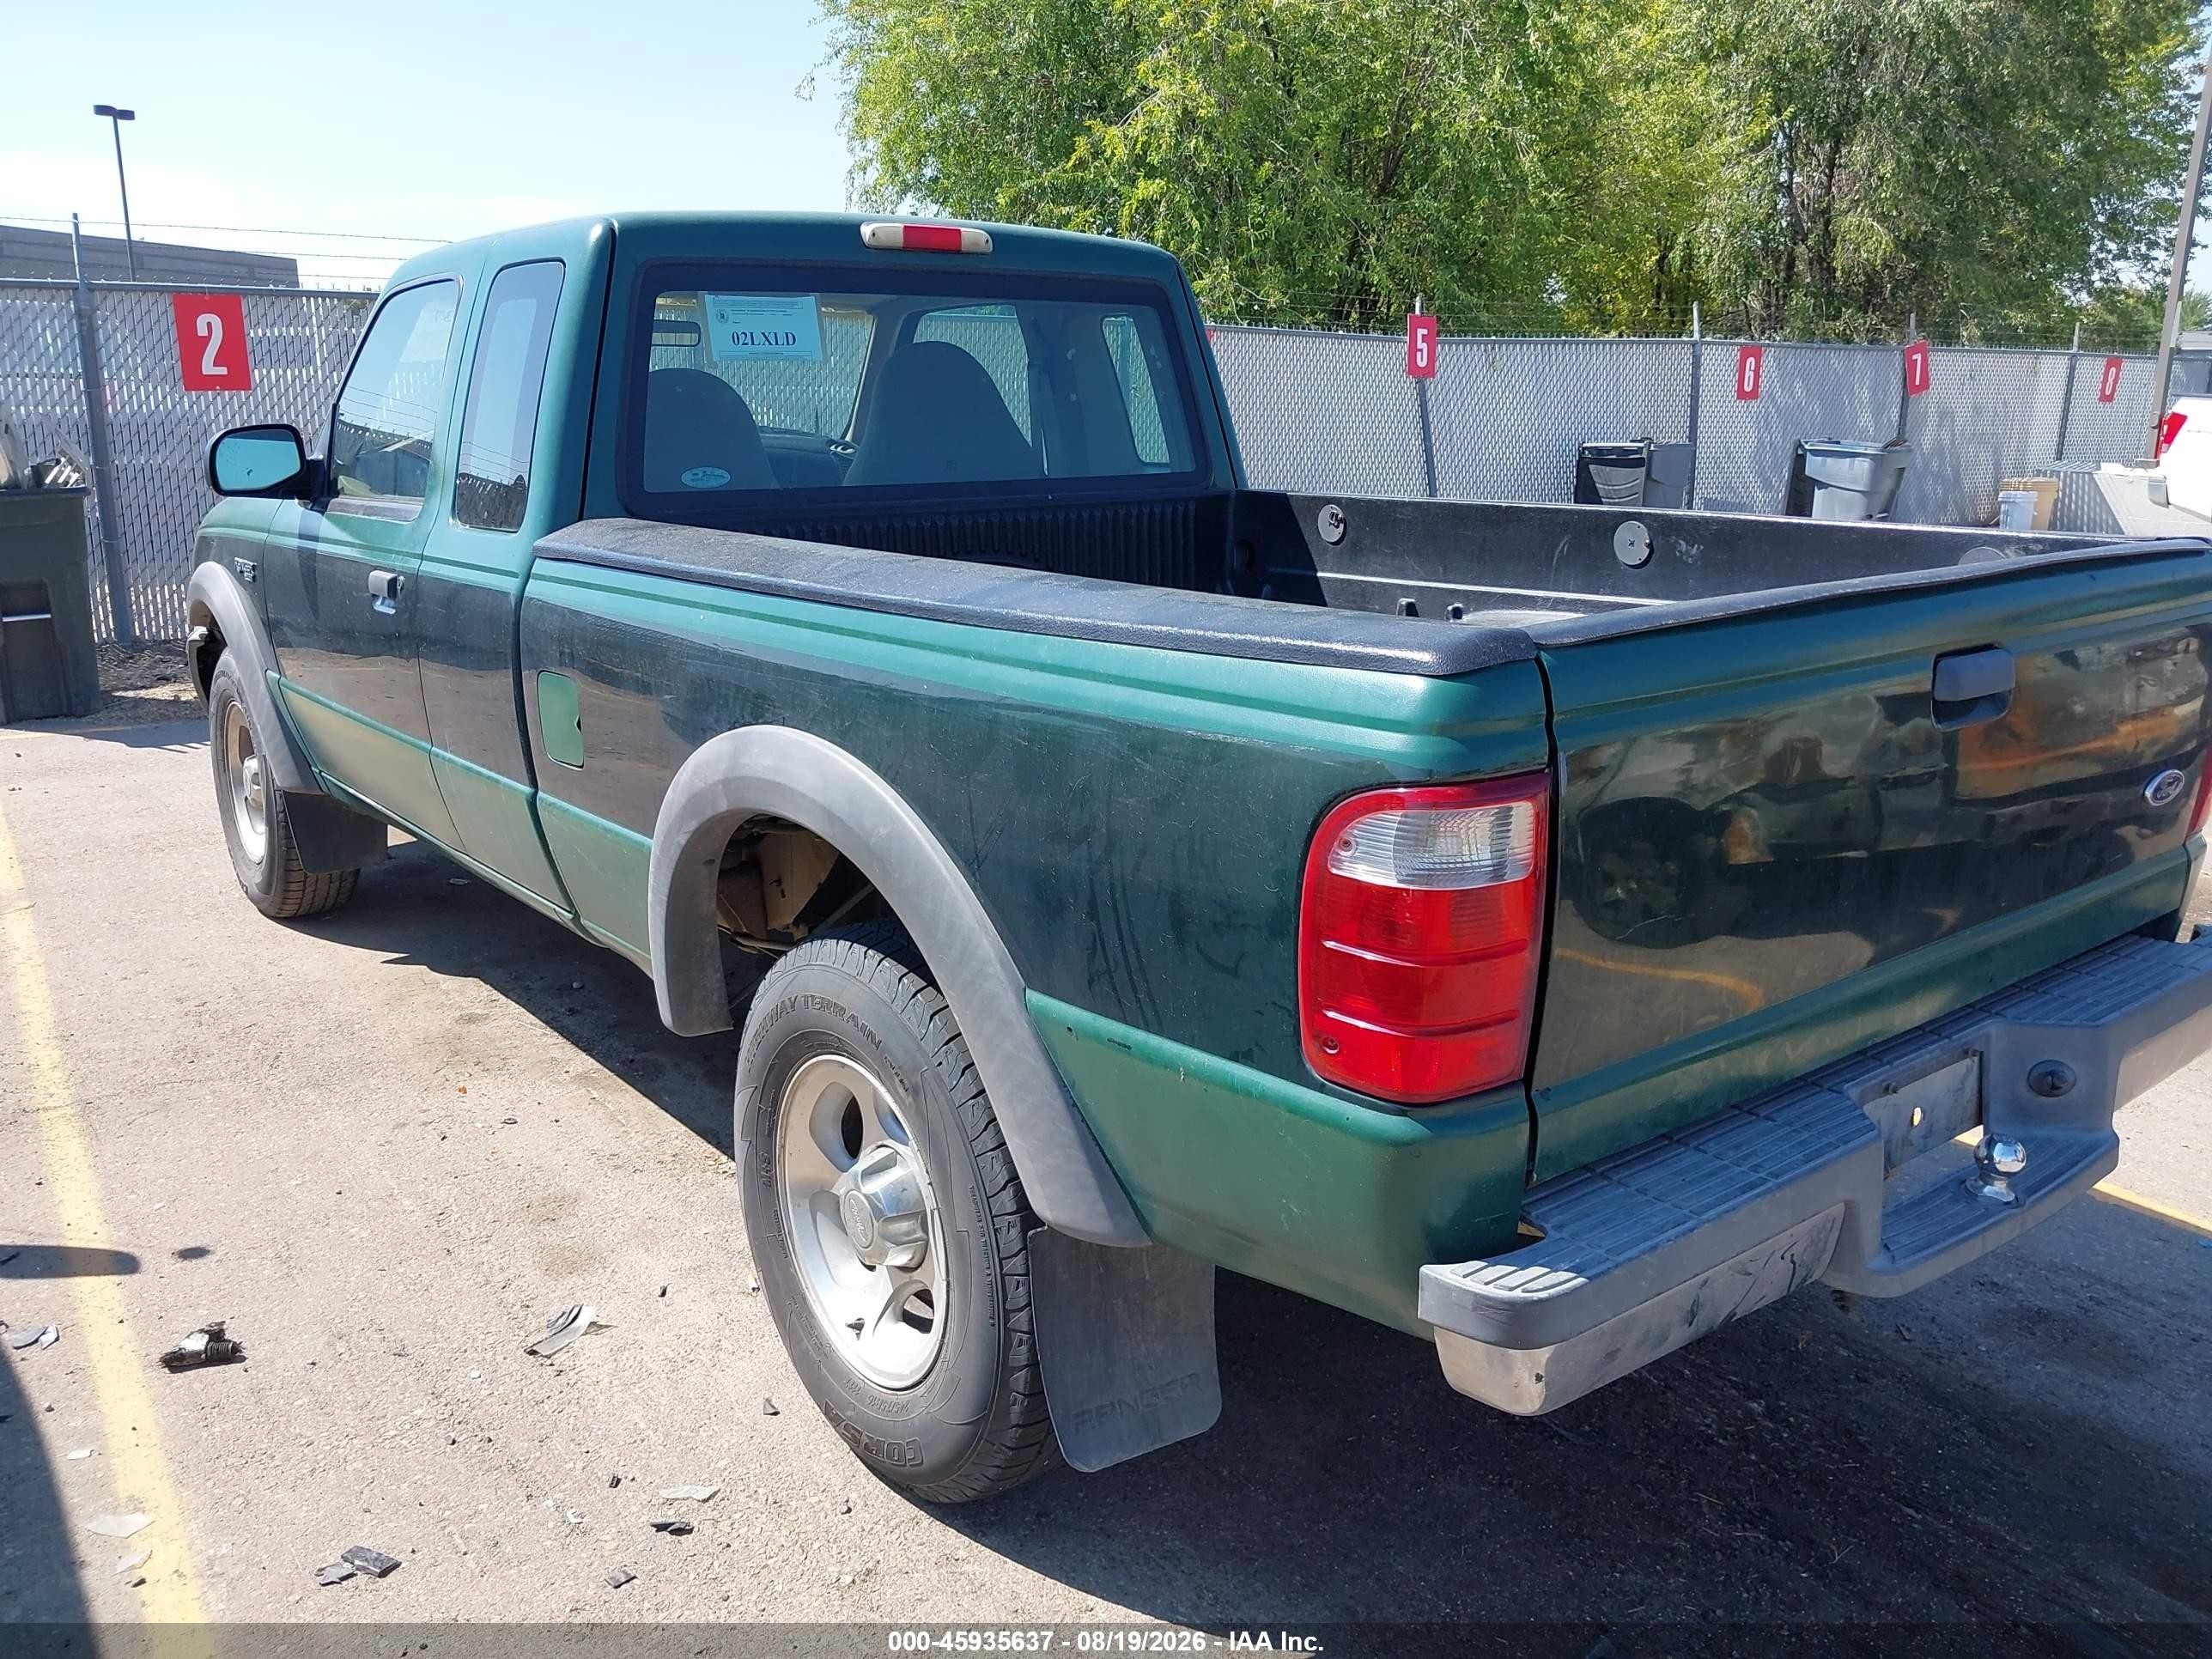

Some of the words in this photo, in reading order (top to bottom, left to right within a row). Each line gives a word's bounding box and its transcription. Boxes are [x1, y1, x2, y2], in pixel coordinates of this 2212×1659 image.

[196, 313, 228, 375] 2
[732, 331, 796, 346] 02LXLD
[1416, 328, 1428, 368] 5
[1743, 356, 1756, 392] 6
[1911, 353, 1922, 386] 7
[2105, 367, 2116, 396] 8
[801, 994, 882, 1051] TERRAIN
[1073, 1371, 1202, 1433] RANGER
[823, 1399, 925, 1468] CORSA
